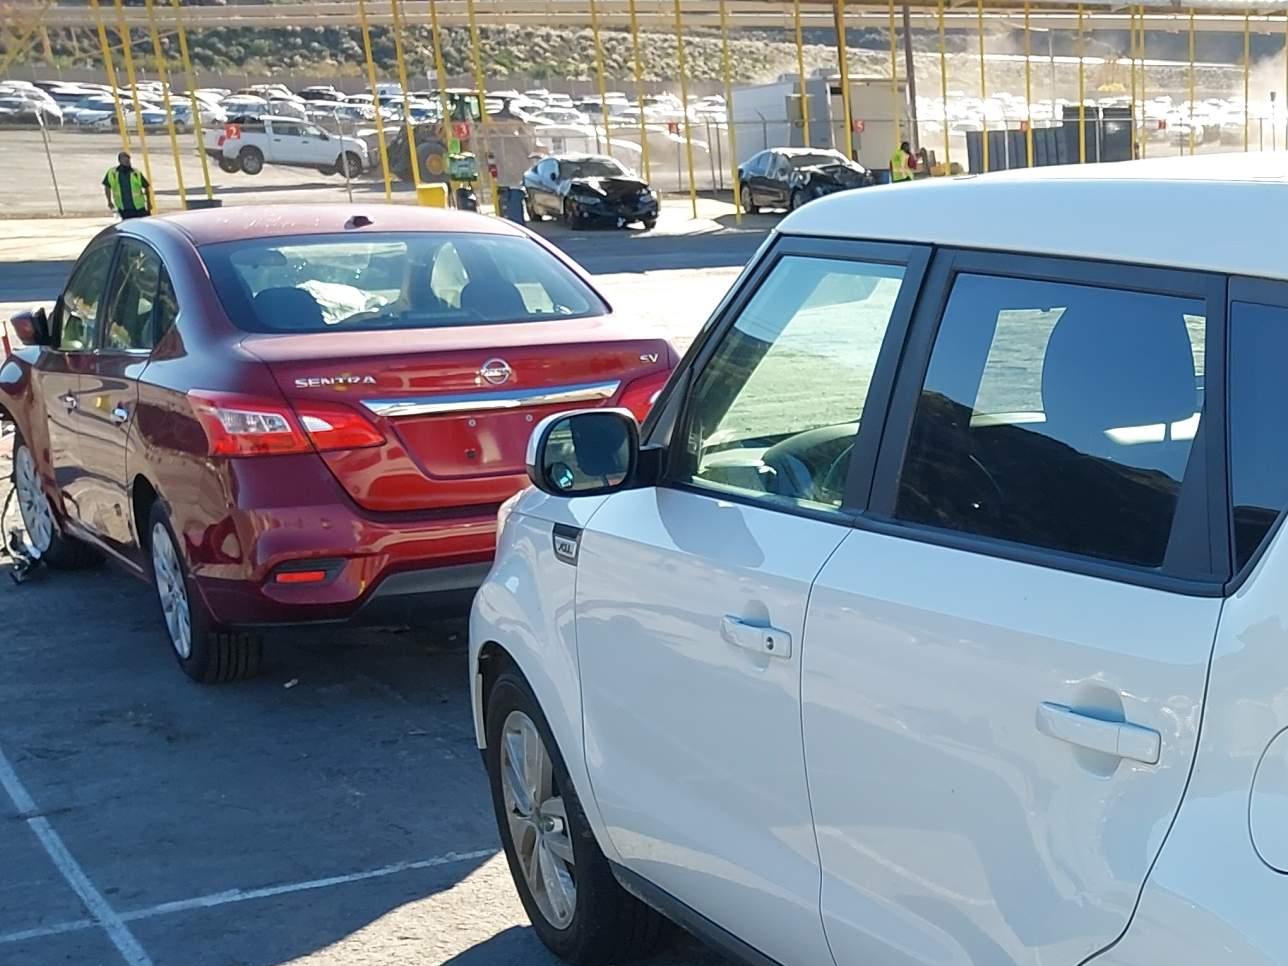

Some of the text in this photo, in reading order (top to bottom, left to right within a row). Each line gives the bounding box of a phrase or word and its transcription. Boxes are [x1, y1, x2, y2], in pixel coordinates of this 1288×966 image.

[229, 126, 238, 138] 2
[639, 353, 659, 363] SV
[295, 375, 377, 388] SENTRA
